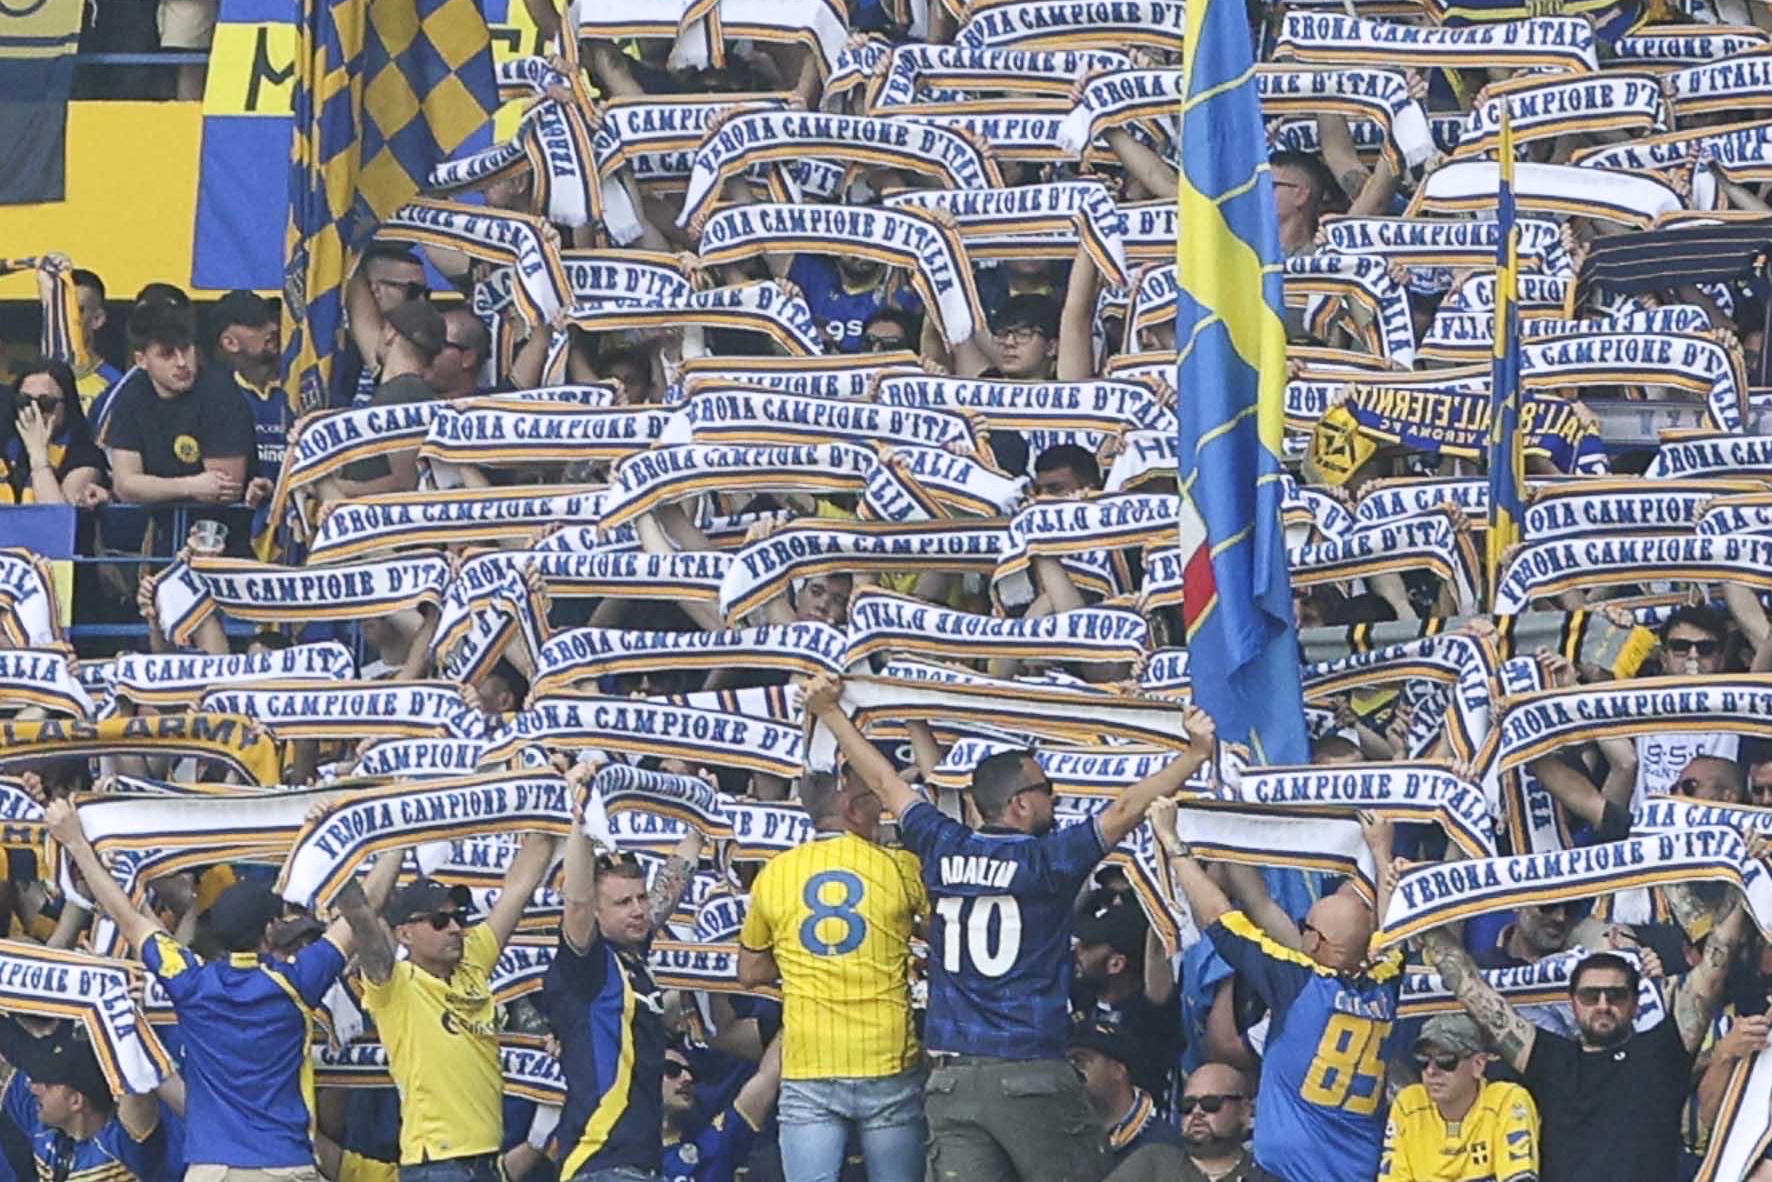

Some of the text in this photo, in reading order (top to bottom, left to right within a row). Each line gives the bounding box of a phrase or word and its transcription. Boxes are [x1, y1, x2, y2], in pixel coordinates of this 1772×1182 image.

[1020, 0, 1143, 36] CAMPIONE
[1289, 18, 1496, 45] ERONA CAMPIONE
[698, 116, 907, 171] VERONA CAMPIONE
[759, 211, 877, 237] CAMPIONE
[1541, 340, 1672, 364] CAMPIONE
[956, 381, 1081, 410] CAMPIONE
[514, 416, 638, 442] CAMPIONE
[759, 397, 882, 430] CAMPIONE
[619, 449, 697, 491] VERONA
[745, 534, 841, 578] VERONA
[1502, 538, 1713, 601] VERONA CAMPIONE
[245, 576, 375, 602] CAMPIONE
[145, 651, 273, 681] CAMPIONE
[267, 691, 398, 718] CAMPIONE
[1576, 692, 1715, 720] CAMPIONE
[595, 707, 747, 747] CAMPIONE
[1256, 773, 1394, 801] CAMPIONE
[317, 786, 507, 857] VERONA CAMPIONE
[1401, 860, 1499, 908] VERONA
[1507, 845, 1645, 884] CAMPIONE
[799, 869, 868, 956] 8
[935, 894, 1023, 978] 10
[1301, 1013, 1394, 1115] 85
